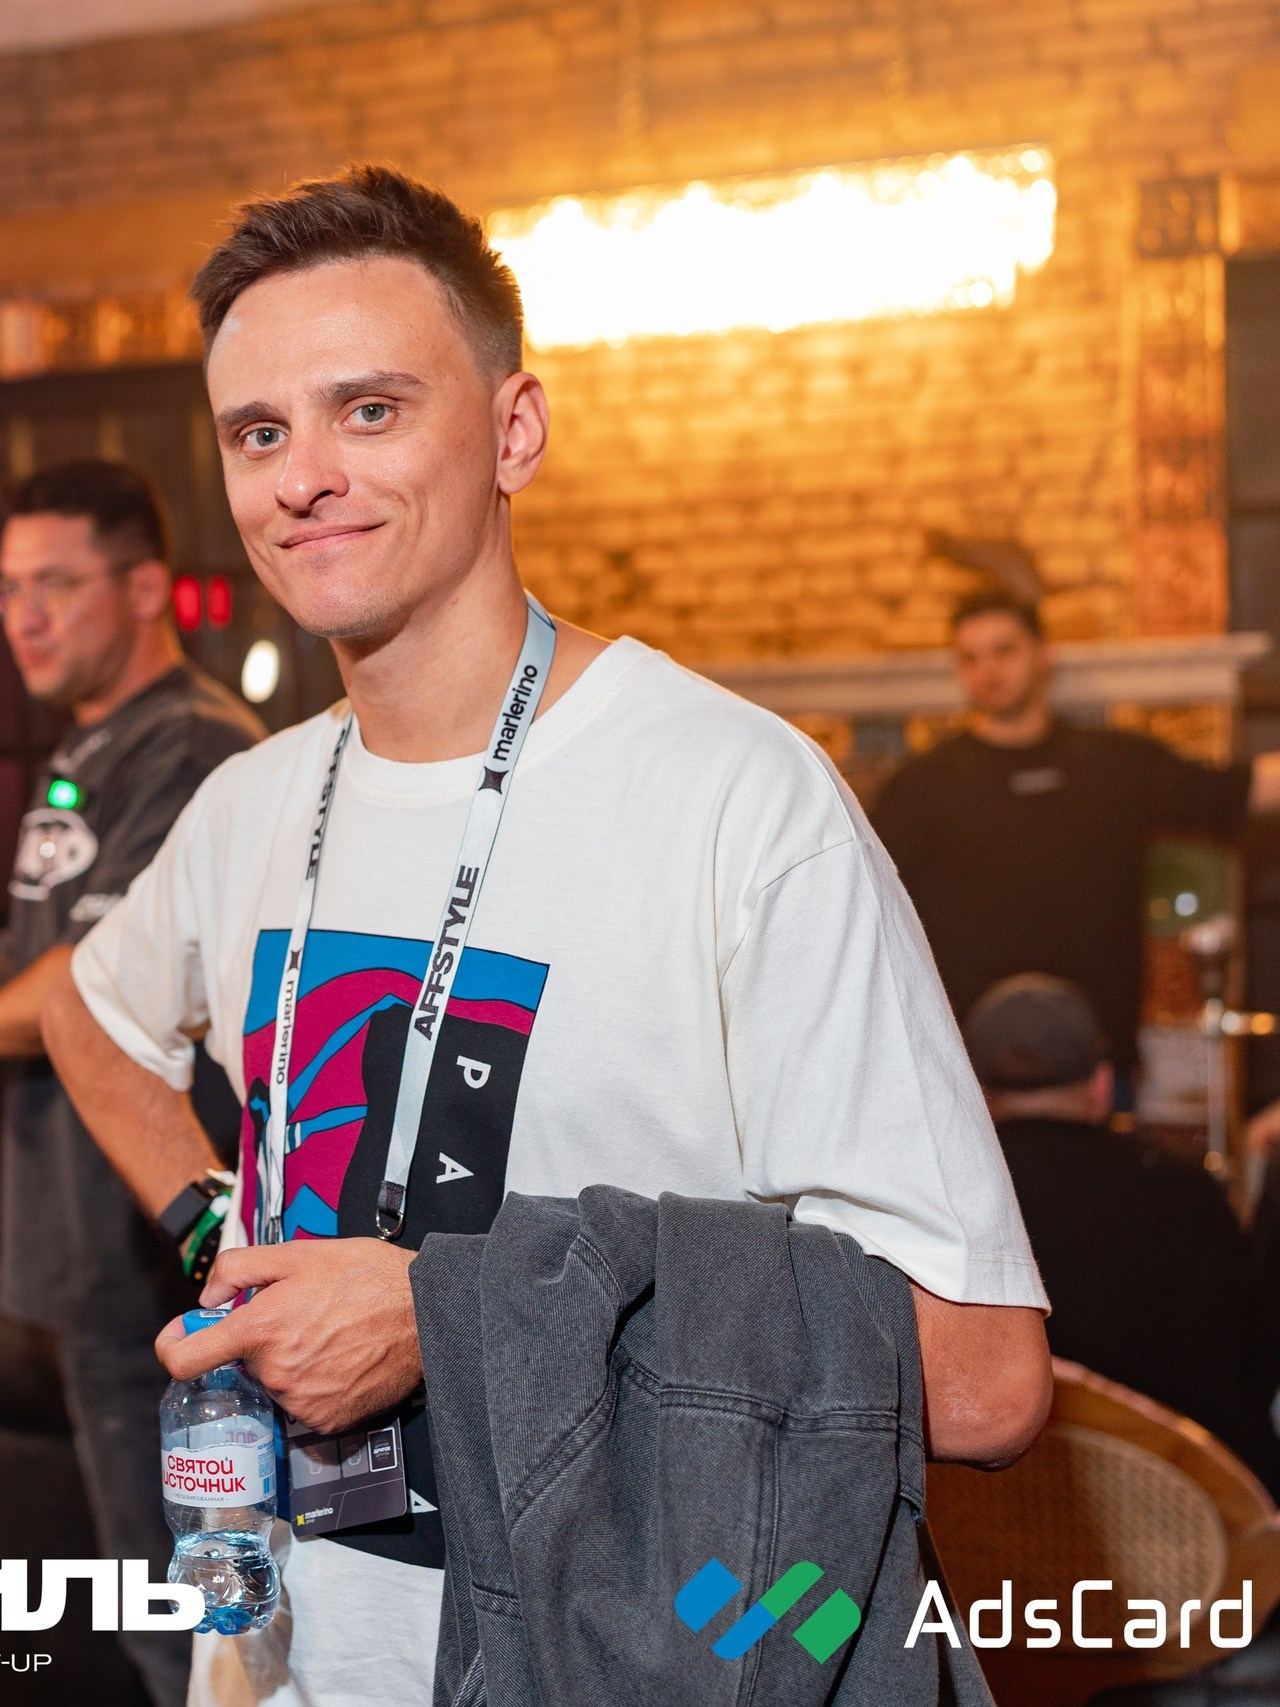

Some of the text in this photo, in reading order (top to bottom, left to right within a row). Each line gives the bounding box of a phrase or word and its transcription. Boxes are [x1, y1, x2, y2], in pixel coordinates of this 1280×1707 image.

[493, 665, 538, 761] marlerino
[414, 865, 480, 1041] AFFSTYLE
[276, 980, 295, 1085] marlerino
[167, 1455, 234, 1475] СВЯТОЙ
